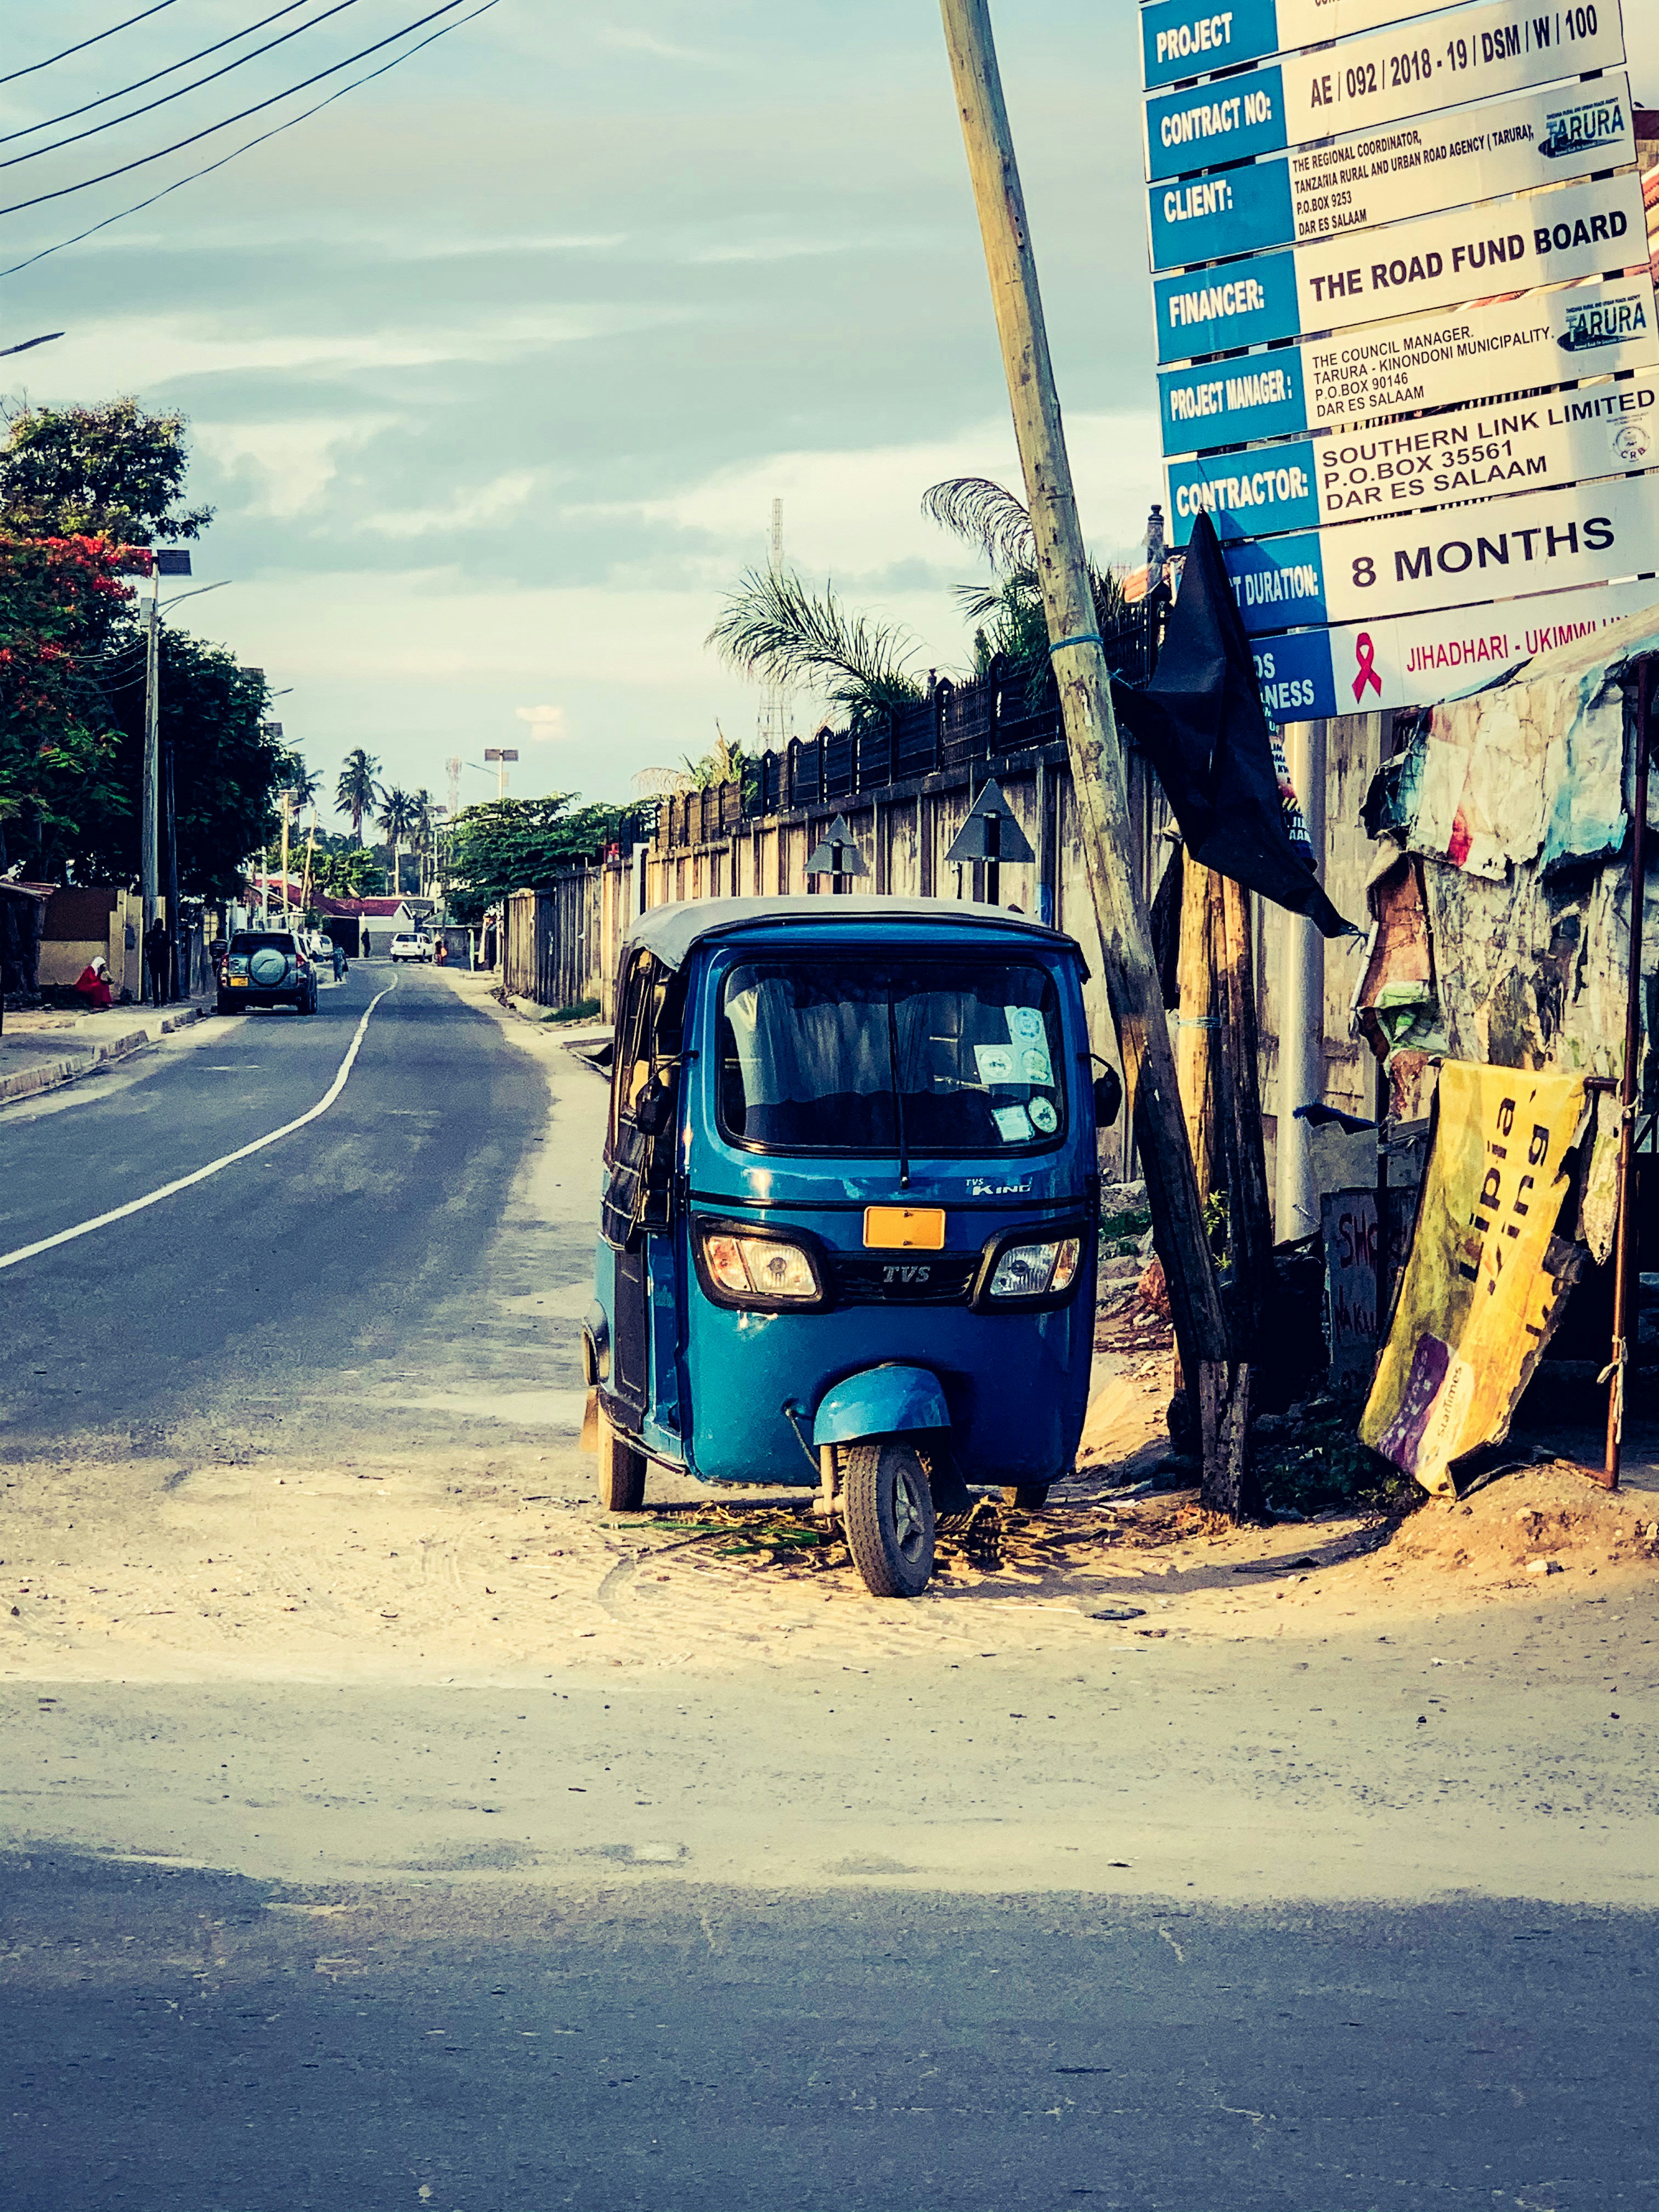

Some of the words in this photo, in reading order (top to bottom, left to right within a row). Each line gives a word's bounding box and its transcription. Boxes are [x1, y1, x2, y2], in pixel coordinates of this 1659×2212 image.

[1156, 12, 1232, 63] PROJECT
[1311, 75, 1333, 108] AE
[1347, 63, 1377, 98] 092
[1391, 48, 1431, 87] 2018
[1447, 39, 1467, 71] 19
[1481, 24, 1521, 63] DSM
[1533, 16, 1550, 49] W
[1565, 4, 1598, 41] 100
[1161, 97, 1240, 147] CONTRACT
[1244, 90, 1272, 126] NO:
[1546, 104, 1624, 148] TARURA
[1293, 157, 1310, 173] THE
[1312, 146, 1355, 168] REGIONAL
[1357, 130, 1422, 157] COORDINATOR,
[1294, 172, 1338, 194] TANZANIA
[1340, 165, 1369, 184] RURAL
[1372, 160, 1389, 177] AND
[1391, 151, 1421, 171] URBAN
[1423, 145, 1447, 163] ROAD
[1449, 135, 1484, 157] AGENCY
[1164, 179, 1233, 223] CLIENT:
[1297, 195, 1330, 215] P.O.BOX
[1331, 190, 1352, 207] 9253
[1299, 221, 1317, 235] DAR
[1318, 217, 1329, 231] ES
[1331, 208, 1367, 229] SALAAM
[1310, 268, 1363, 302] THE
[1371, 252, 1443, 290] ROAD
[1452, 234, 1525, 273] FUND
[1533, 210, 1628, 255] BOARD
[1169, 279, 1265, 328] FINANCER:
[1566, 302, 1646, 342] TARURA
[1312, 353, 1338, 369] THE
[1341, 341, 1400, 363] COUNCIL
[1403, 326, 1474, 351] MANAGER.
[1313, 364, 1368, 385] TARURA
[1379, 346, 1453, 373] KINONDONI
[1457, 326, 1554, 357] MUNICIPALITY.
[1170, 381, 1223, 421] PROJECT
[1316, 379, 1369, 401] P.O.BOX
[1372, 372, 1408, 390] 90146
[1317, 401, 1345, 417] DAR
[1348, 397, 1365, 411] ES
[1369, 385, 1424, 408] SALAAM
[1323, 426, 1468, 467] SOUTHERN
[1477, 411, 1539, 439] LINK
[1548, 390, 1655, 426] LIMITED
[1324, 454, 1433, 489] P.O.BOX
[1441, 439, 1512, 468] 35561
[1327, 487, 1383, 511] DAR
[1391, 479, 1424, 499] ES
[1434, 455, 1547, 491] SALAAM
[1176, 466, 1309, 517] CONTRACTOR:
[1352, 556, 1376, 588] 8
[1394, 517, 1615, 582] MONTHS
[1245, 564, 1318, 606] DURATION:
[1407, 634, 1509, 673] JIHADHARI
[966, 1178, 984, 1186] TVS
[883, 1266, 931, 1283] TVS
[1437, 1366, 1462, 1437] StarTimes
